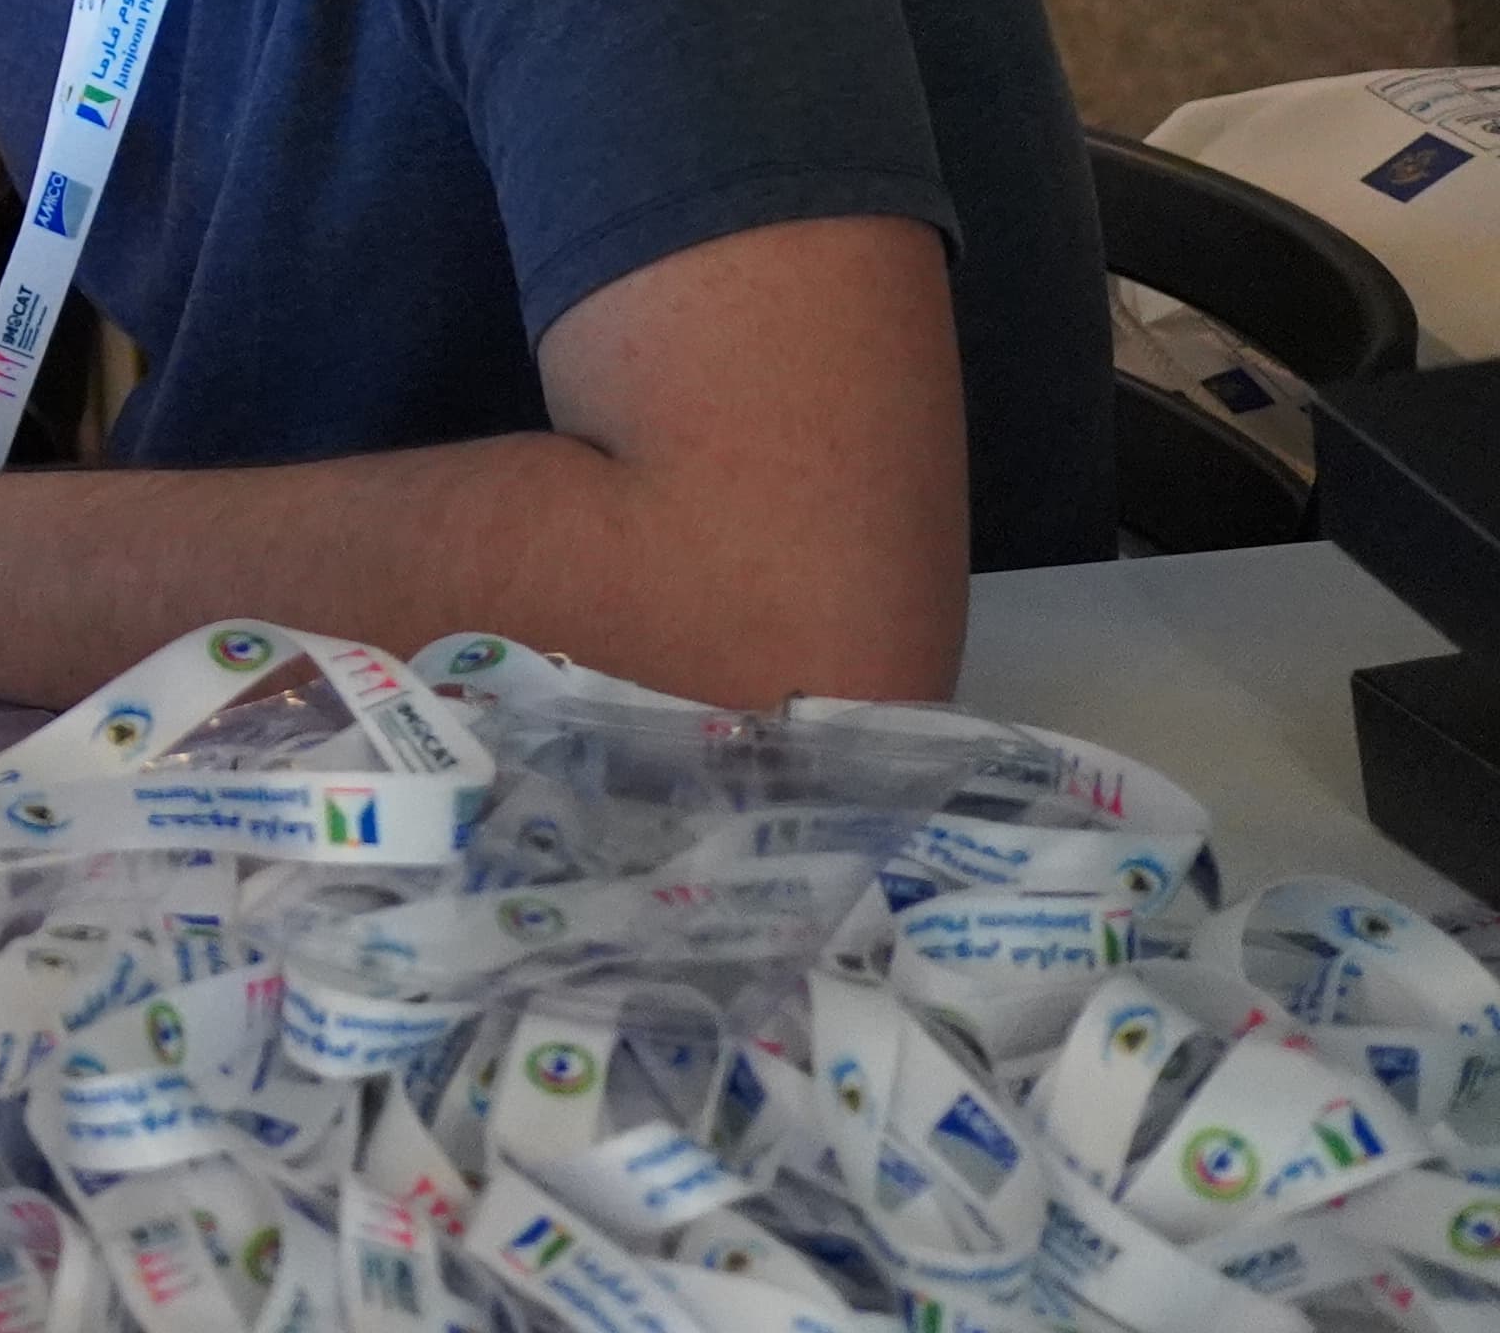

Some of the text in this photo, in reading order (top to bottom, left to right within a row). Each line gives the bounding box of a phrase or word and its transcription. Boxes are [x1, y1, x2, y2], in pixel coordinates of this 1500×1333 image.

[91, 26, 121, 80] فارما
[112, 17, 148, 90] Jamjoom
[36, 174, 66, 228] AMICO
